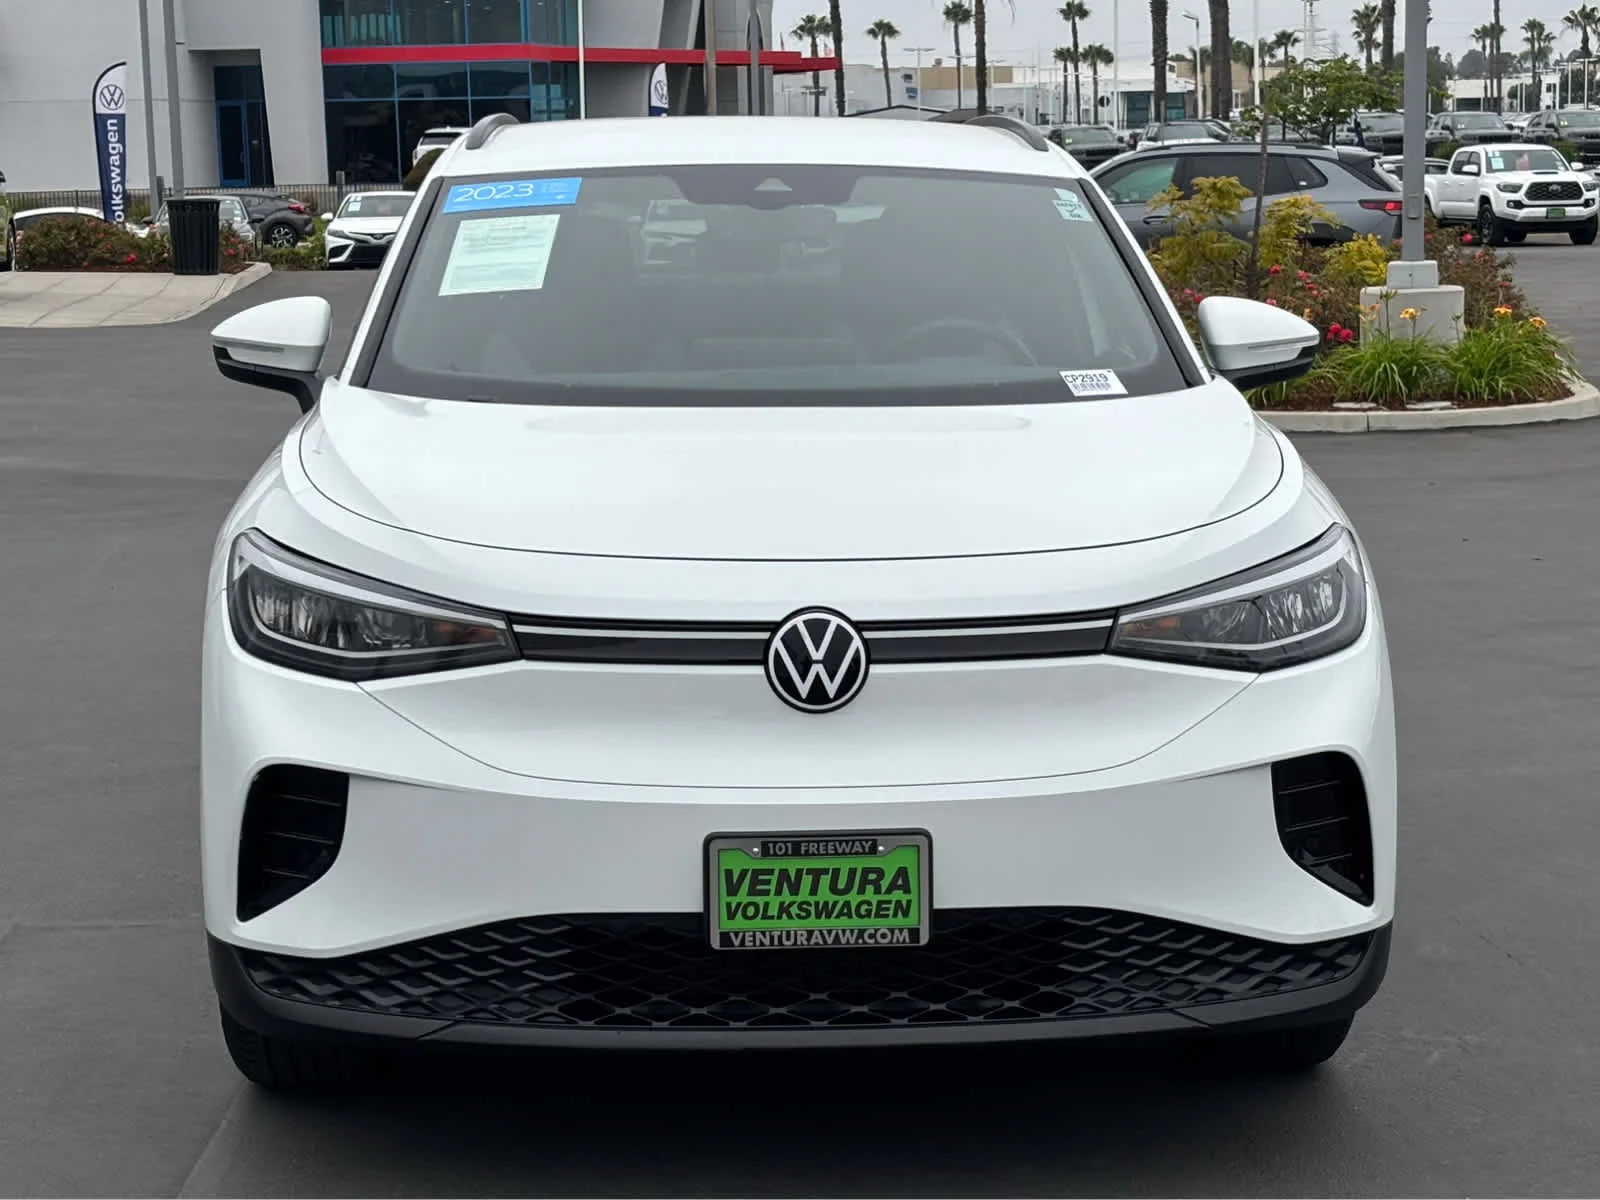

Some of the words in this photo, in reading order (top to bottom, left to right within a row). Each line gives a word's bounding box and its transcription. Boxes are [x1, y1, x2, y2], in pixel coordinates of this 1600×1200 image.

[101, 84, 124, 109] VW
[106, 119, 125, 224] olkswagen
[453, 183, 534, 202] 2023
[1064, 373, 1109, 384] CP2919
[772, 616, 862, 703] VW
[768, 842, 792, 855] 101
[801, 840, 872, 855] FREEWAY
[723, 866, 912, 897] VENTURA
[726, 899, 912, 921] VOLKSWAGEN
[729, 927, 911, 947] VENTURAVW.COM
